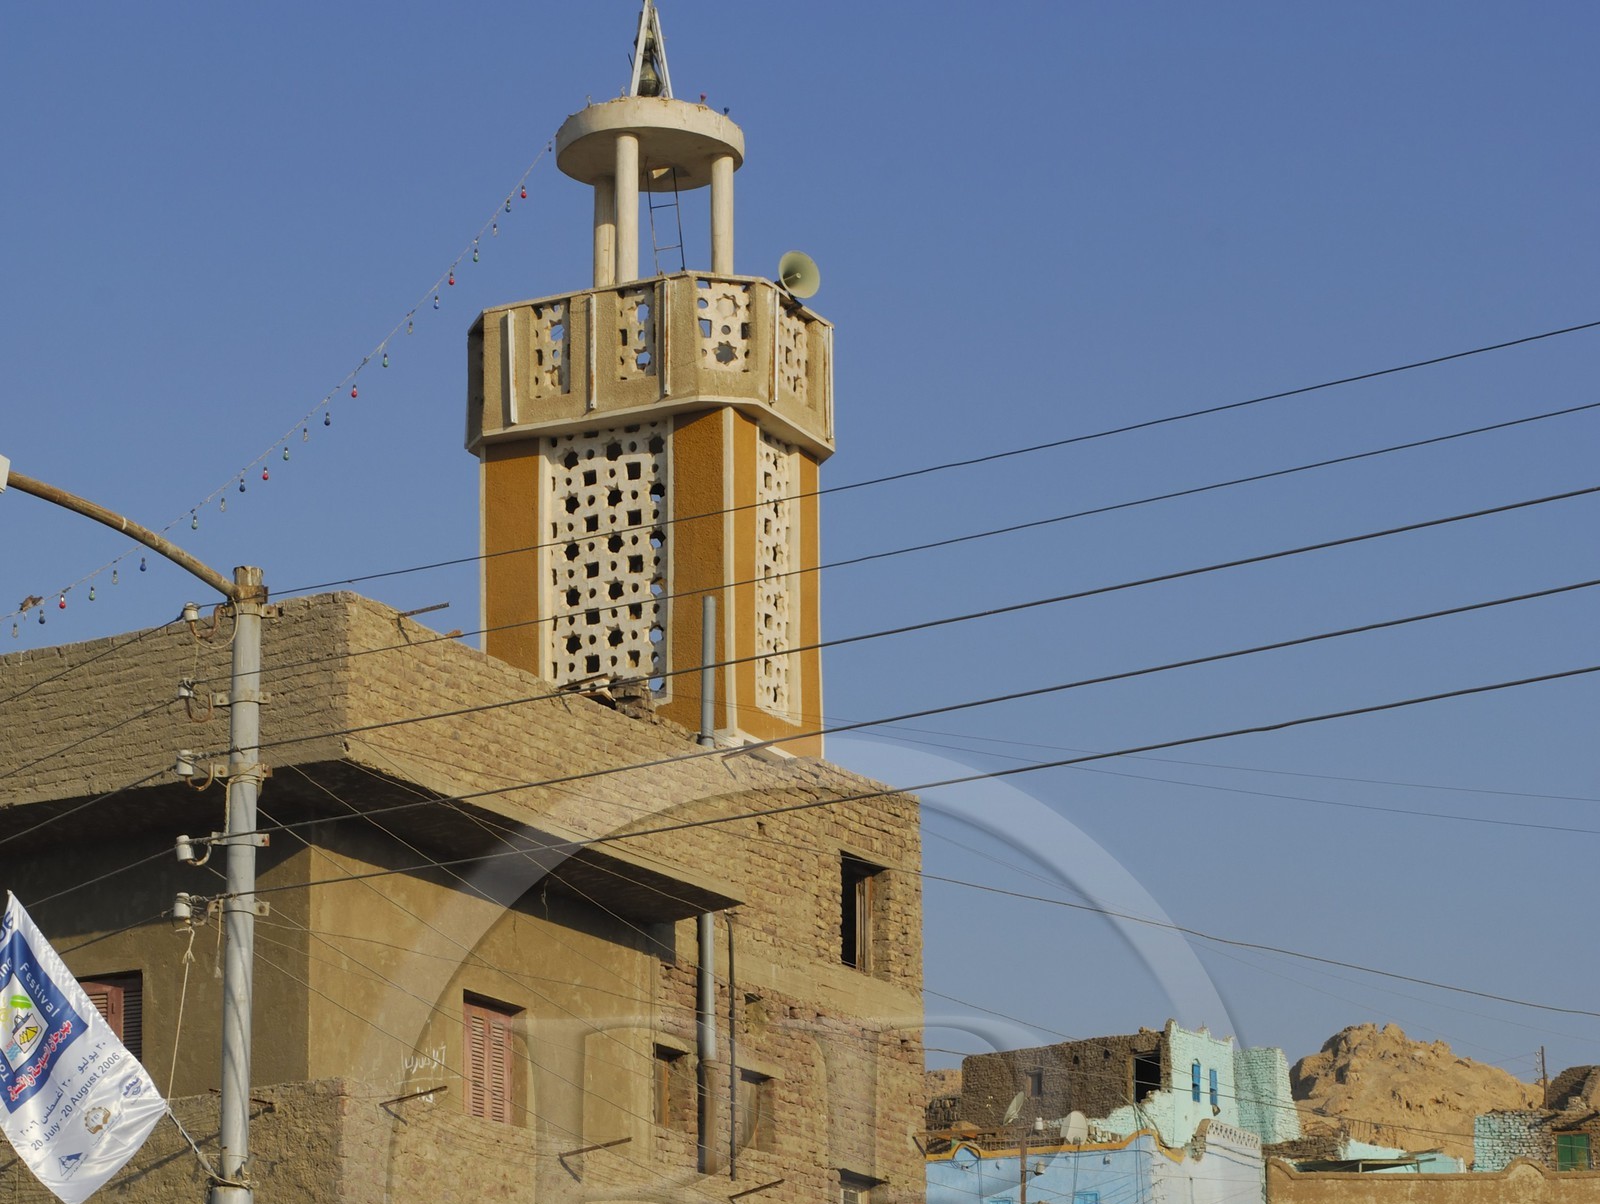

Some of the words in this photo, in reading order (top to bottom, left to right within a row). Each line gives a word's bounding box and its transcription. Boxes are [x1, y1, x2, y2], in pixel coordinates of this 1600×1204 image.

[19, 962, 60, 1018] Festival
[49, 1020, 73, 1051] مهرجان
[27, 1045, 51, 1077] السياحة
[77, 1050, 99, 1074] يوليو
[31, 1140, 43, 1151] 20
[45, 1123, 60, 1142] July
[61, 1104, 73, 1117] 20
[72, 1073, 99, 1105] August
[100, 1052, 120, 1073] 2006
